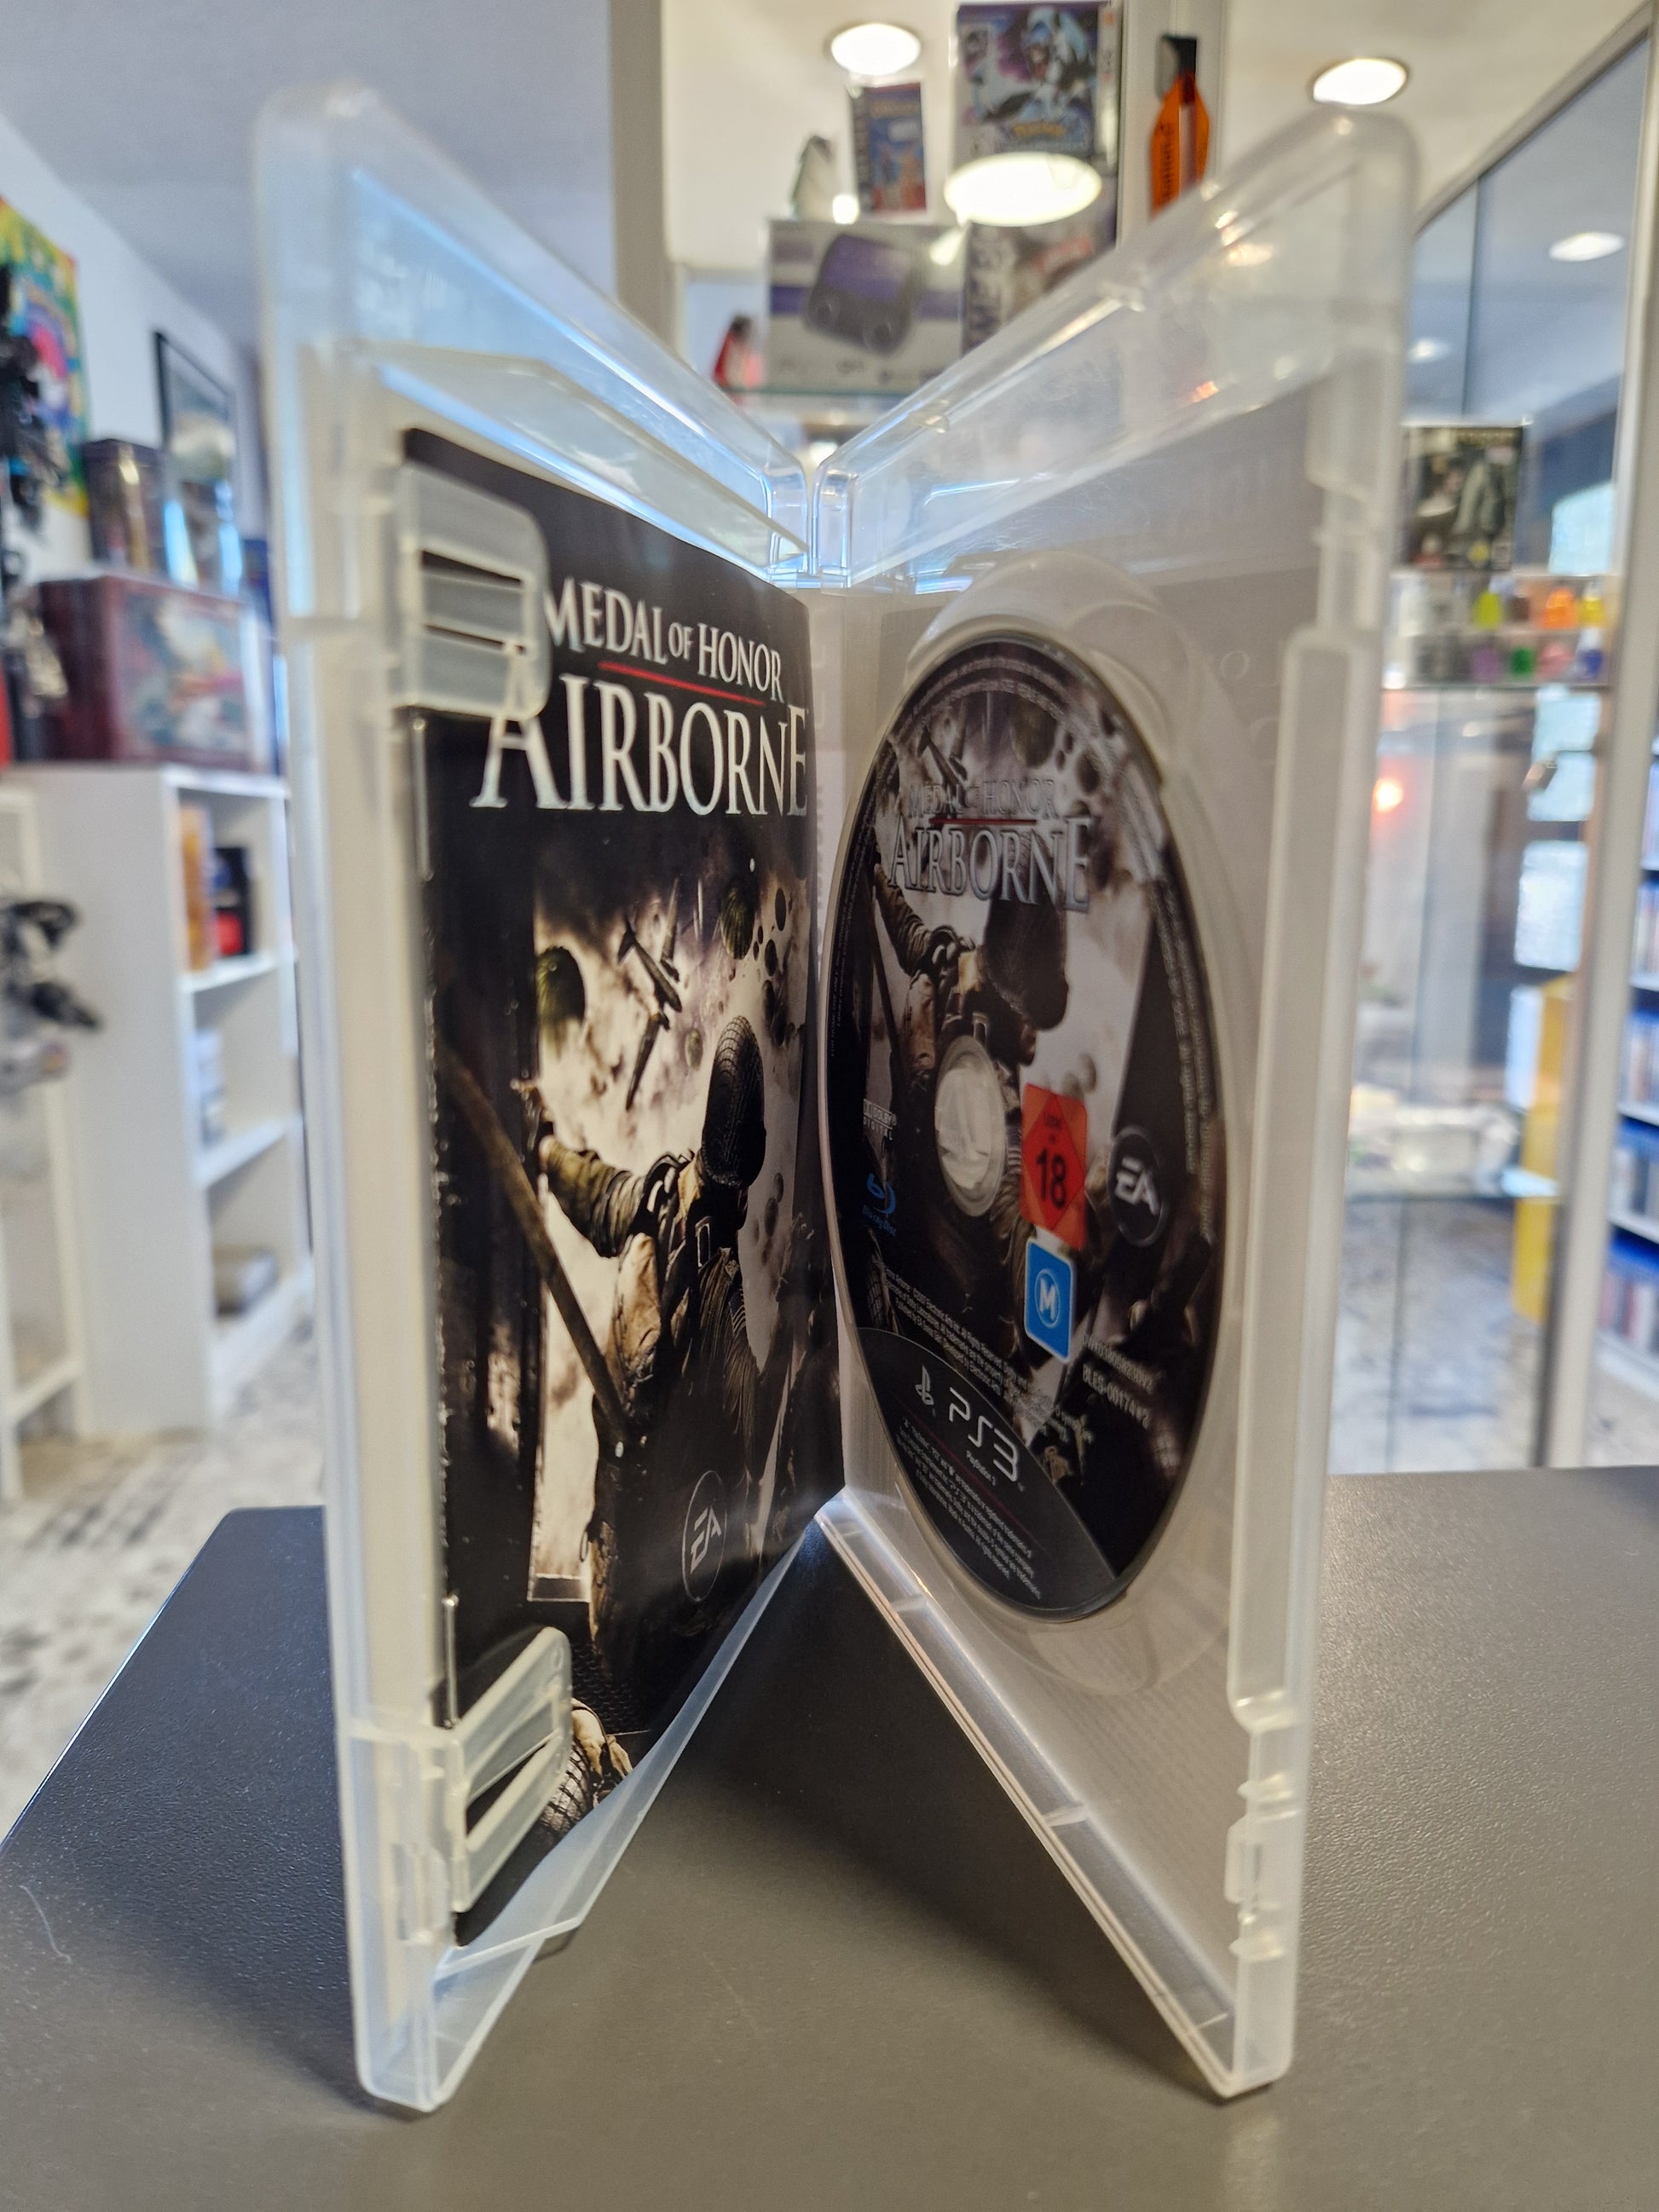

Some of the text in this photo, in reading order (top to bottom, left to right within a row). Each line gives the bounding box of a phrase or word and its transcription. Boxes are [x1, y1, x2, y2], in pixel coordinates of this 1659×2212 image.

[545, 577, 668, 665] MEDAL
[697, 623, 784, 704] HONOR
[469, 648, 808, 816] AIRBORNE
[908, 783, 962, 819] MEDAL
[982, 778, 1060, 820] HONOR
[887, 815, 1093, 914] AIRBORNE
[1036, 1148, 1067, 1210] 18
[1114, 1157, 1159, 1216] EA
[949, 1386, 1018, 1482] PS3
[691, 1505, 722, 1574] EA
